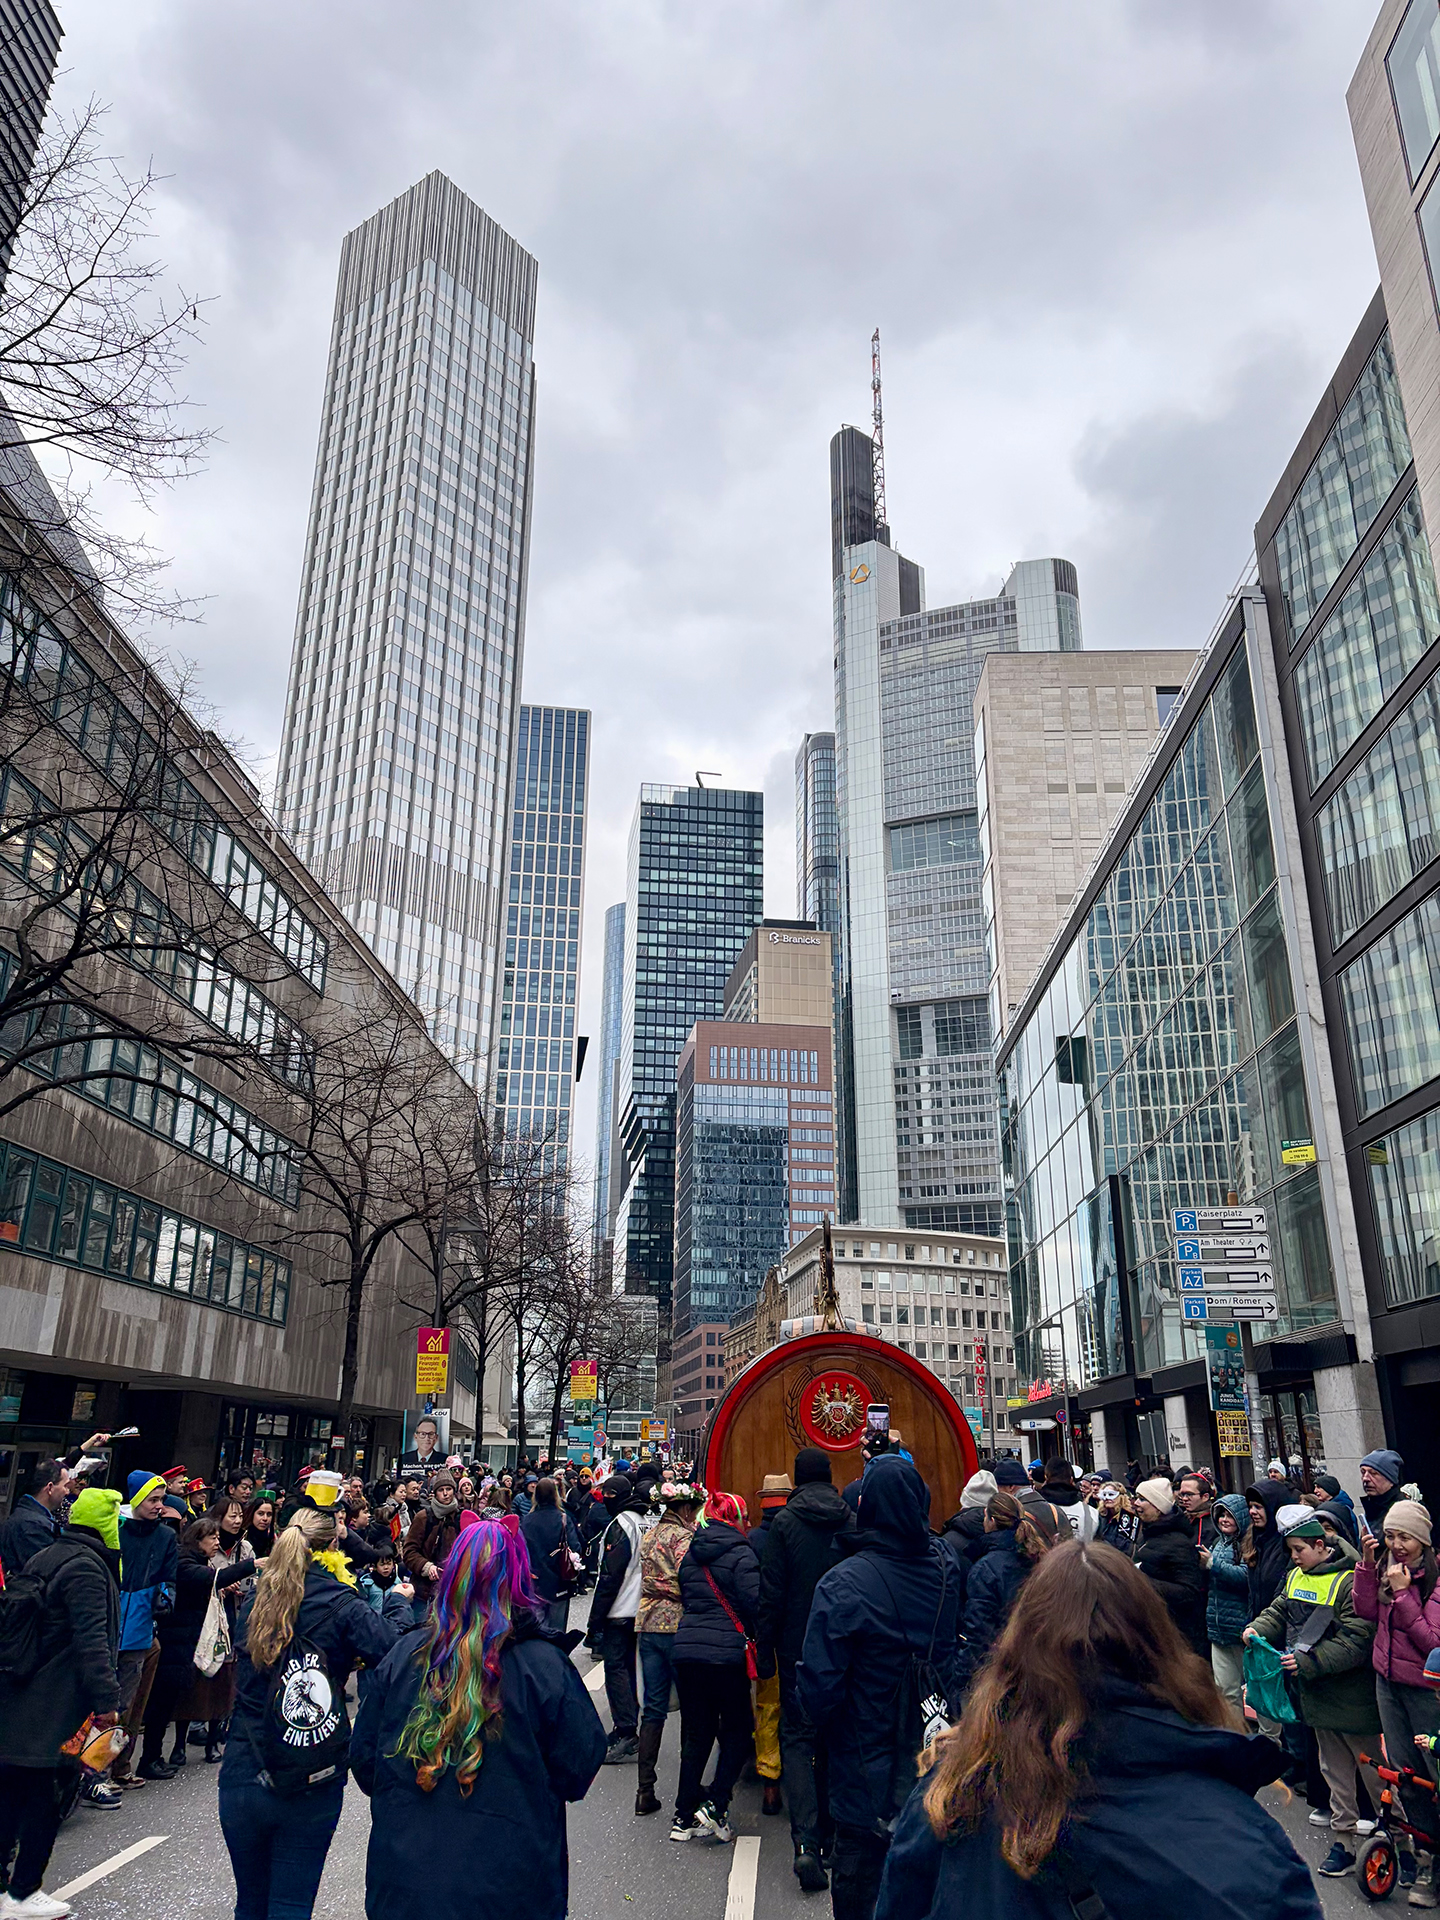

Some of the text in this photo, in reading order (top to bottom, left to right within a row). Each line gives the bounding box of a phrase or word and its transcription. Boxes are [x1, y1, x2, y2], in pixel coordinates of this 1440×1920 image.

[782, 934, 821, 945] Branicks
[1197, 1210, 1242, 1218] Kaiserplatz
[1213, 1238, 1235, 1246] Theater
[1184, 1275, 1202, 1287] AZ
[1191, 1305, 1200, 1317] D
[282, 1711, 341, 1747] EINE LIEBE.
